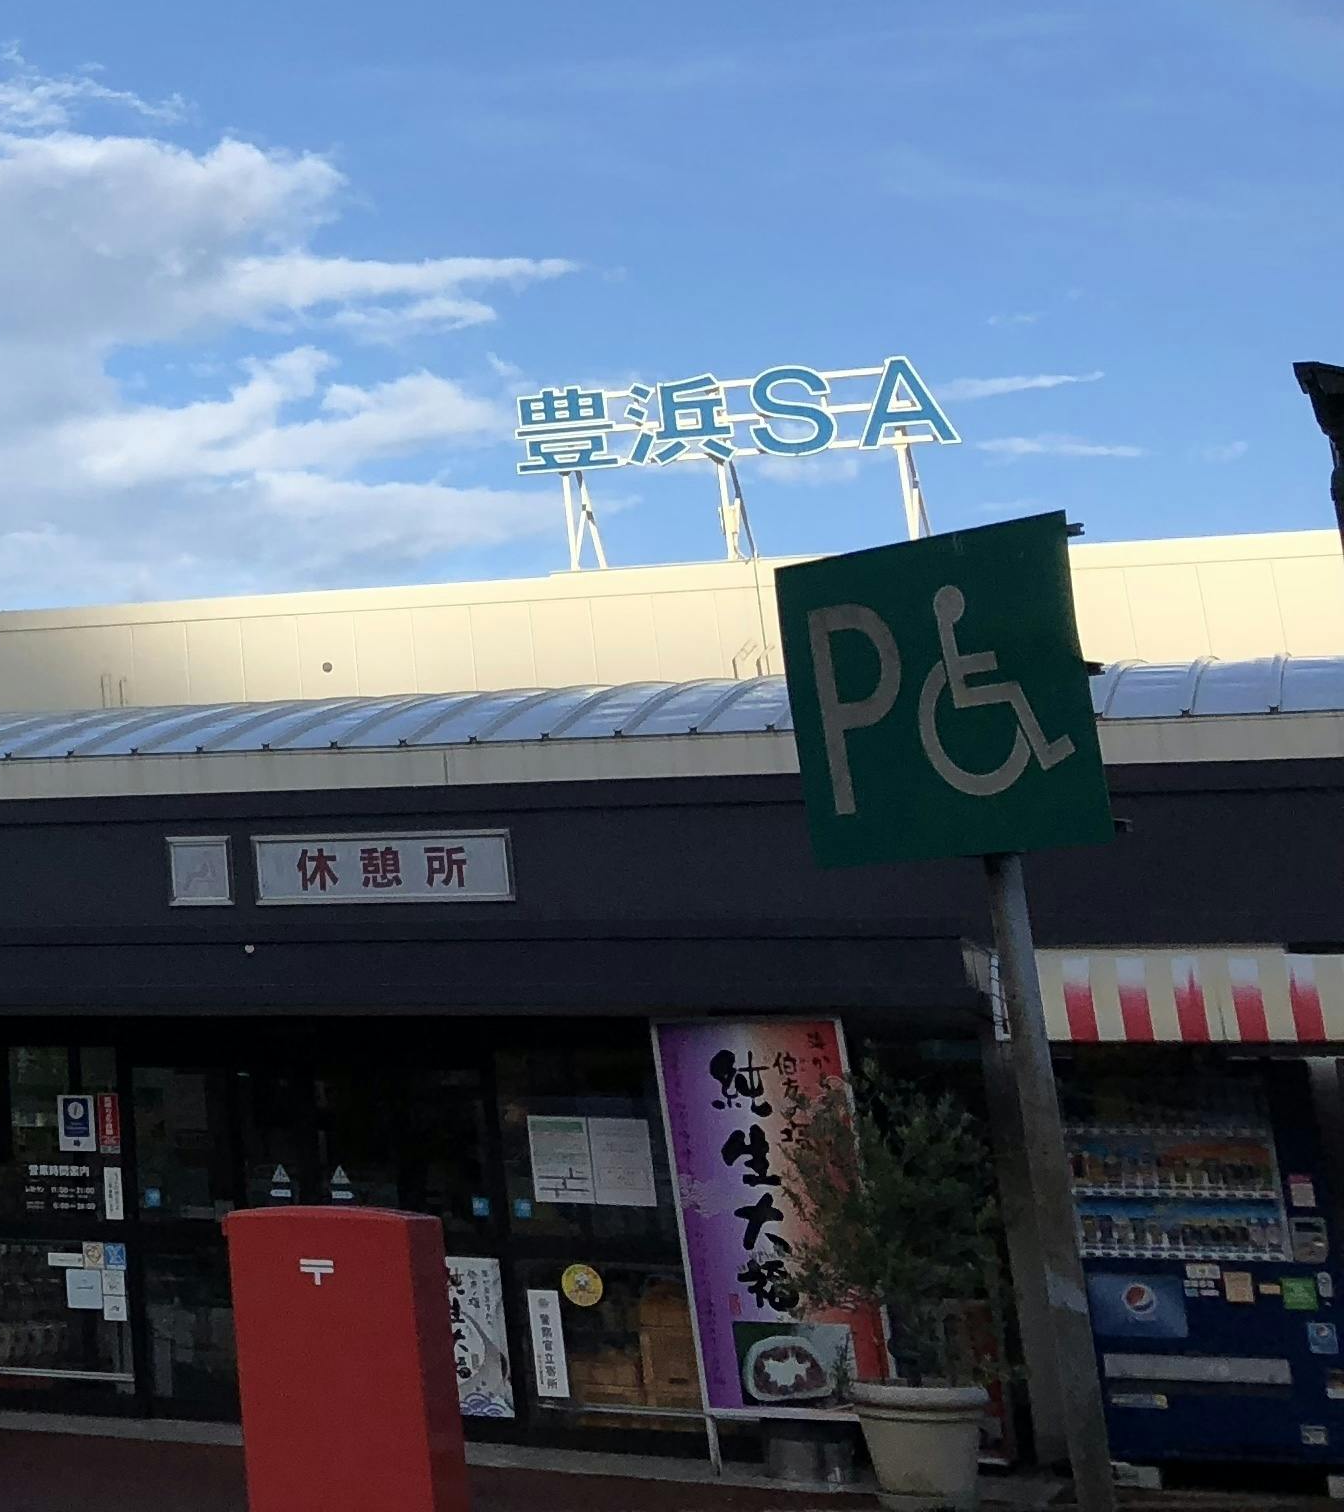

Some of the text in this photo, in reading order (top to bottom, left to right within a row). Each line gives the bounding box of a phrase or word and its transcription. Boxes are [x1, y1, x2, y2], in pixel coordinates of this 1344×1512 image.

[515, 355, 961, 476] 豊浜SA
[807, 603, 902, 817] P
[297, 847, 469, 891] 休憩所
